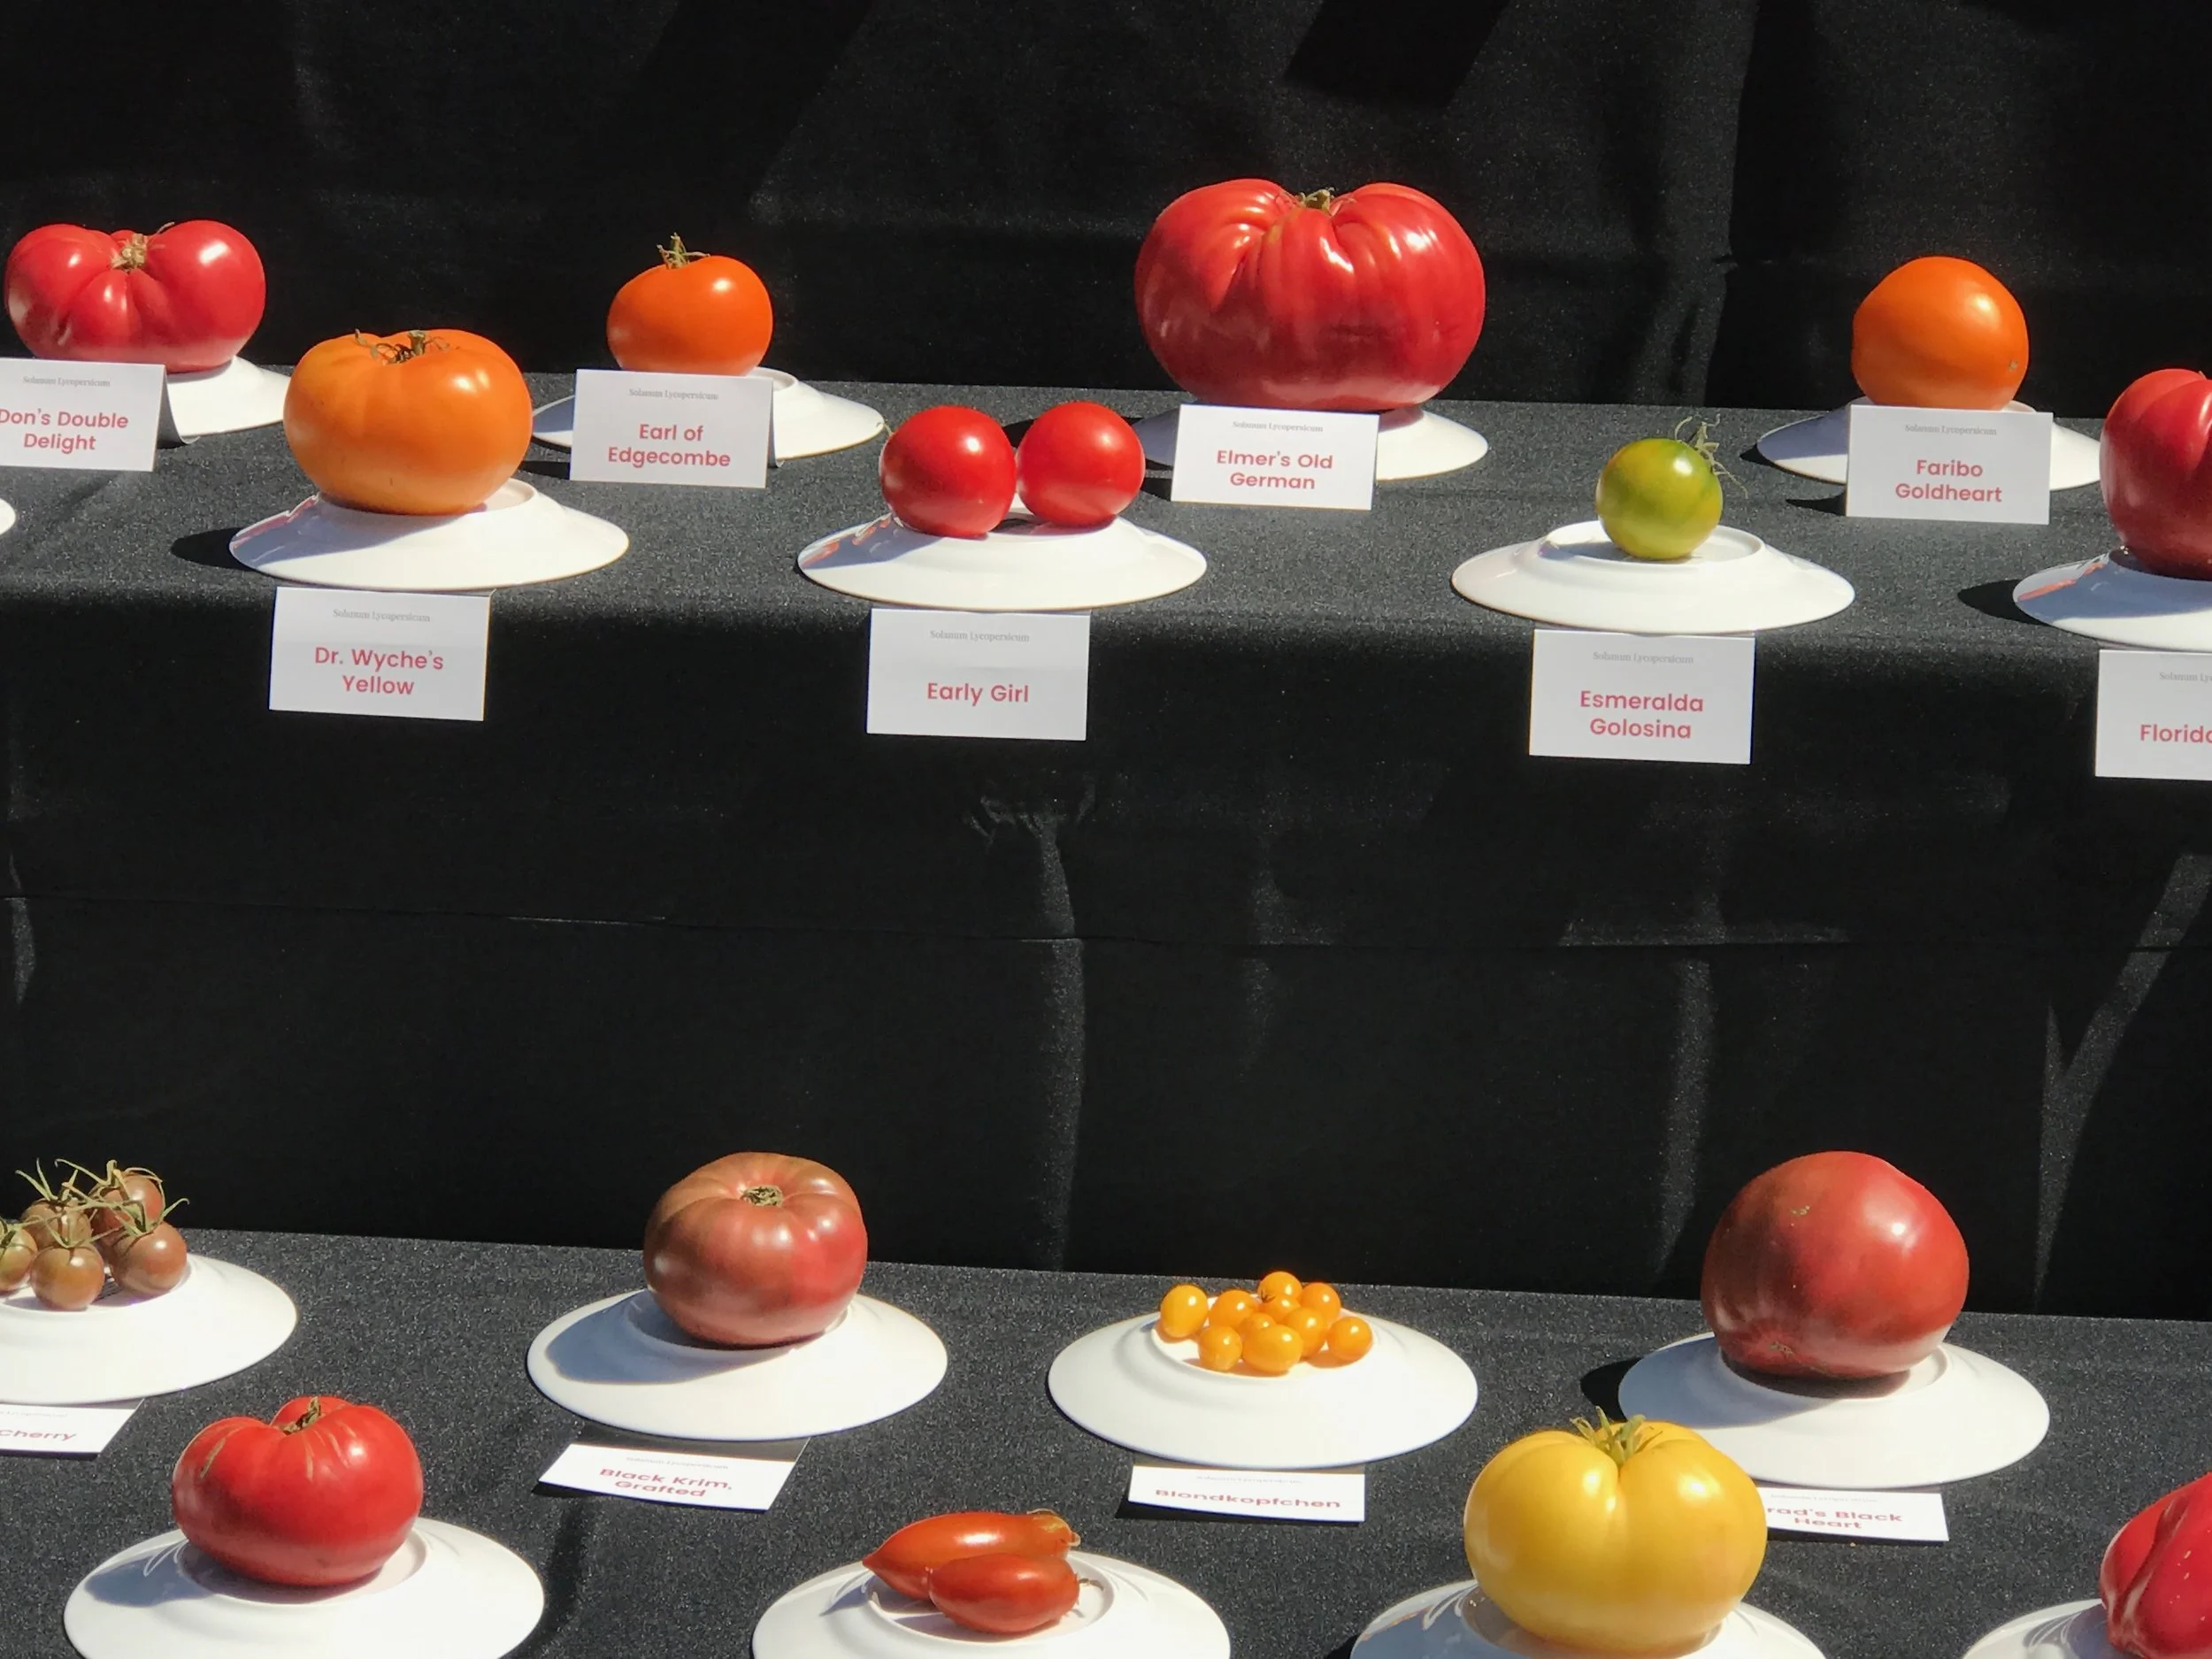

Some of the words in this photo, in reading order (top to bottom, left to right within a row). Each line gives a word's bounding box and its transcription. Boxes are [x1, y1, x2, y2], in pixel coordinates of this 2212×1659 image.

[0, 408, 51, 426] Don's
[58, 411, 128, 428] Double
[639, 424, 677, 441] Earl
[684, 425, 703, 442] of
[24, 434, 96, 454] Delight
[608, 447, 731, 469] Edgecombe
[1217, 449, 1291, 467] Elmer's
[1298, 454, 1333, 469] Old
[1916, 459, 1983, 478] Faribo
[1230, 472, 1316, 490] German
[1895, 482, 2002, 503] Goldheart
[315, 647, 344, 665] Dr.
[351, 649, 444, 672] Wyche's
[342, 675, 415, 695] Yellow
[927, 682, 983, 706] Early
[990, 683, 1029, 703] Girl
[1579, 690, 1703, 712] Esmeralda
[1590, 718, 1692, 739] Golosina
[0, 1429, 77, 1442] Cherry
[599, 1468, 665, 1483] Black
[672, 1476, 733, 1491] Krim,
[614, 1480, 707, 1497] Grafted
[1767, 1507, 1827, 1517] rad's
[1834, 1510, 1903, 1522] Black
[1793, 1517, 1863, 1530] Heart
